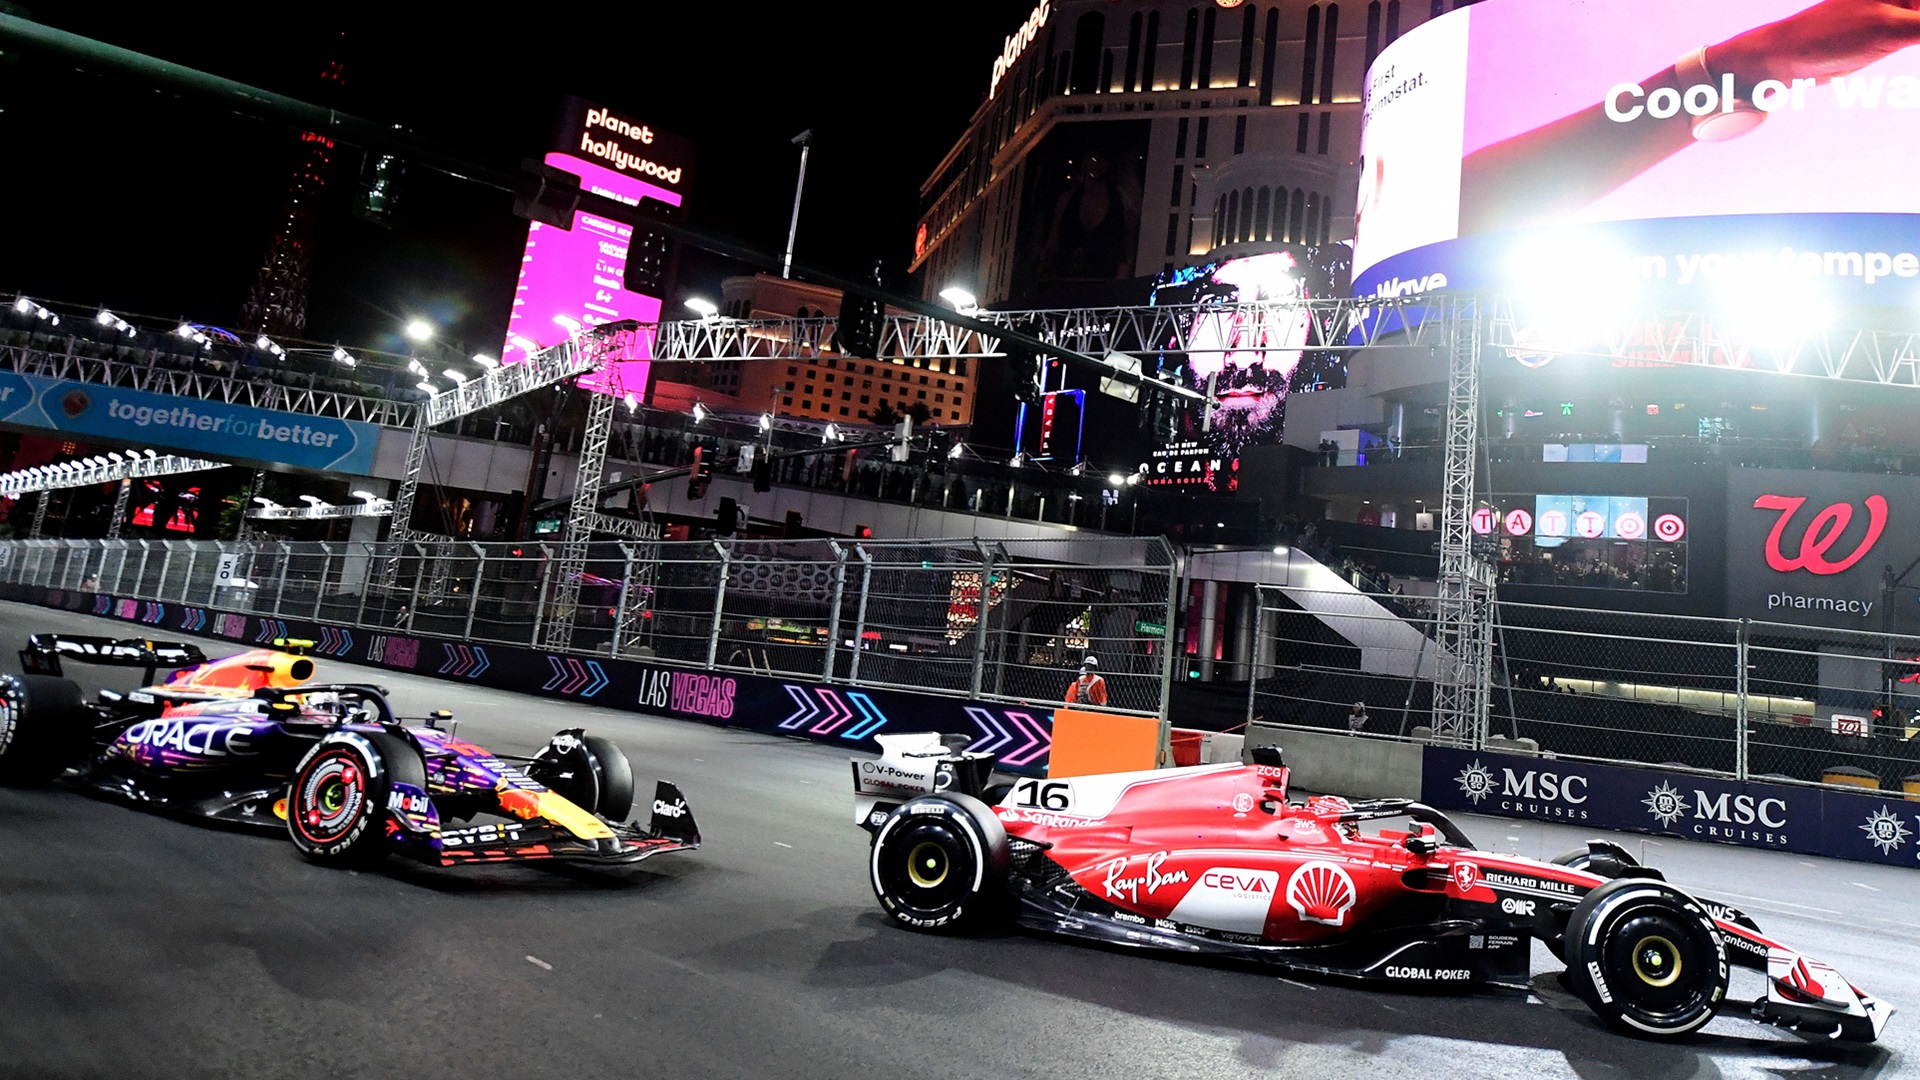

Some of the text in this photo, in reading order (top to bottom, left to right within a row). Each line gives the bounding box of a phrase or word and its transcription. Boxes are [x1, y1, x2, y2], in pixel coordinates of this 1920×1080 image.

[1604, 73, 1734, 122] Cool
[1752, 77, 1816, 112] or
[585, 108, 654, 144] planet
[580, 132, 682, 184] hollywood
[1139, 459, 1221, 475] OCEAN
[1768, 592, 1873, 617] pharmacy
[1140, 623, 1164, 634] Harmon
[367, 635, 387, 662] LAS
[639, 669, 737, 719] LAS VEGAS
[126, 719, 261, 756] ORACLE
[876, 765, 926, 780] V-Power
[1257, 766, 1281, 778] ZCG
[863, 778, 897, 788] GLOBAL
[1502, 767, 1588, 804] MSC
[388, 791, 430, 813] Mobil
[1017, 781, 1069, 811] 16
[653, 799, 682, 818] Claro
[1501, 801, 1588, 819] CRUISES
[1693, 789, 1787, 829] MSC
[1021, 810, 1106, 828] Santander
[1294, 820, 1316, 829] aws
[1693, 825, 1788, 844] CRUISES
[1486, 873, 1575, 893] RICHARD MILLE
[1233, 892, 1272, 901] LOGISTICS
[897, 912, 949, 927] ZERO
[1114, 911, 1146, 924] brembo
[1155, 918, 1177, 930] NGK
[1385, 965, 1471, 980] GLOBAL POKER
